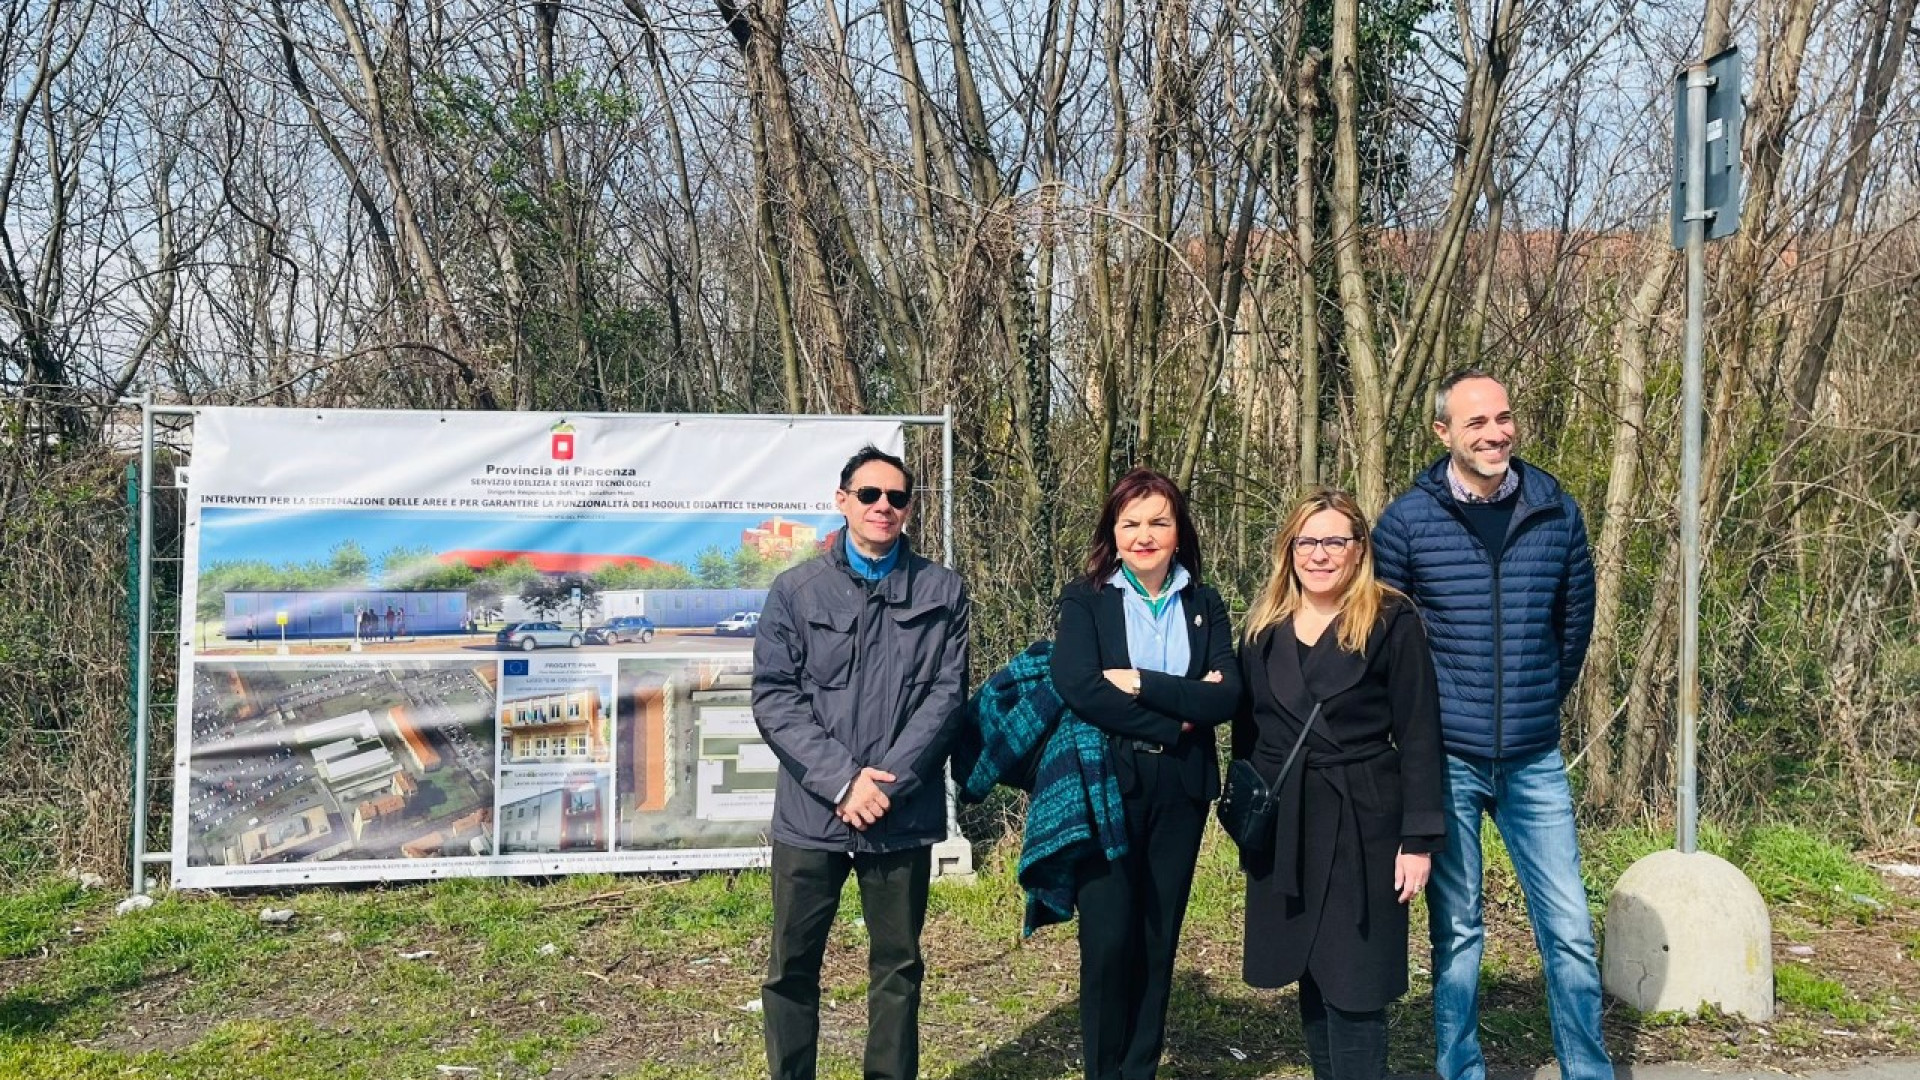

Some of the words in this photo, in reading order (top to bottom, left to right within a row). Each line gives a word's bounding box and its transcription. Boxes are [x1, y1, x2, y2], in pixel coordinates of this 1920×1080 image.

[486, 464, 552, 476] Provincia
[557, 465, 569, 476] di
[573, 466, 637, 477] Piacenza
[471, 478, 511, 486] SERVIZIO
[513, 479, 551, 487] EDILIZIA
[553, 479, 558, 487] E
[560, 479, 593, 487] SERVIZI
[596, 479, 651, 488] TECNOLOGICI
[200, 494, 267, 505] INTERVENTI
[270, 496, 290, 505] PER
[293, 496, 306, 505] LA
[308, 496, 385, 506] SISTEMAZIONE
[388, 497, 419, 506] DELLE
[422, 498, 448, 507] AREE
[451, 498, 457, 507] E
[460, 499, 478, 508] PER
[481, 499, 539, 508] GARANTIRE
[542, 500, 554, 508] LA
[557, 498, 629, 509] FUNZIONALITÀ
[632, 500, 649, 509] DEI
[652, 501, 691, 510] MODULI
[693, 501, 743, 510] DIDATTICI
[746, 501, 807, 511] TEMPORANEI
[815, 502, 832, 511] CIG
